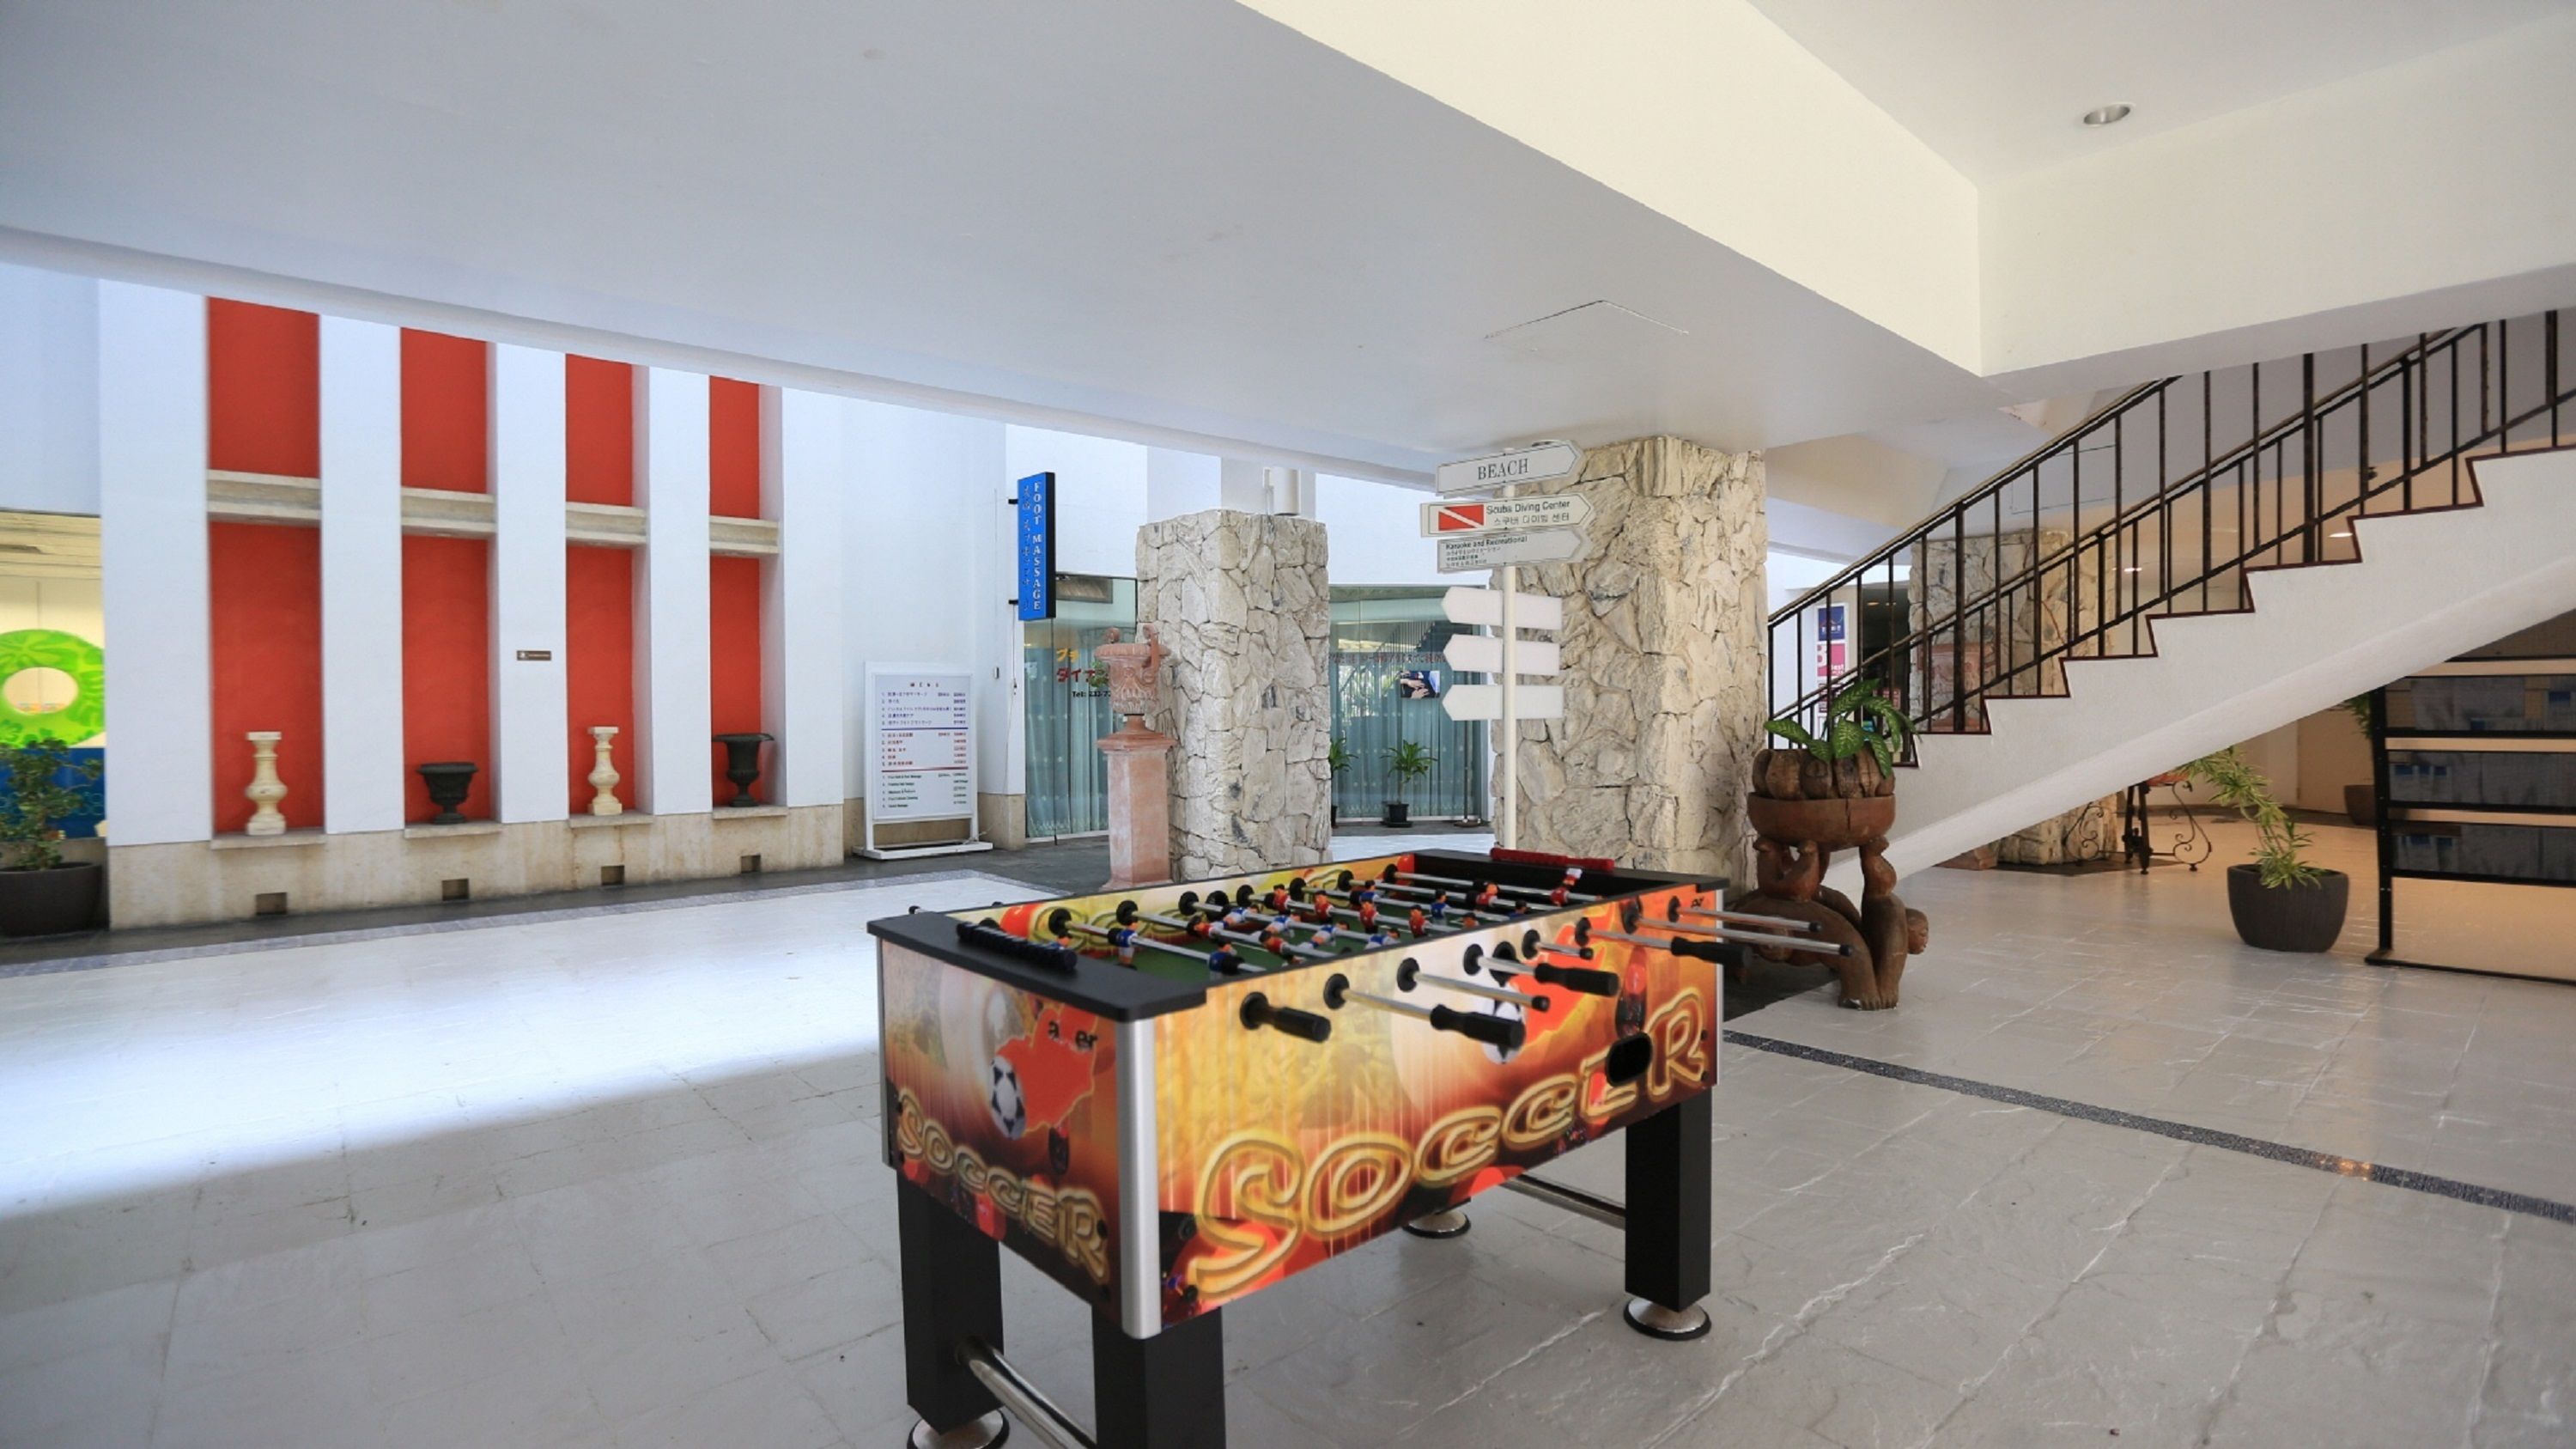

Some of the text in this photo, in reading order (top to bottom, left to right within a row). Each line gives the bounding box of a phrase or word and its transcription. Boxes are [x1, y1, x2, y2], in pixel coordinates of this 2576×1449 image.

[1478, 458, 1528, 480] BEACH
[1515, 502, 1540, 513] Diving
[1542, 501, 1570, 510] Center
[1032, 481, 1042, 610] FOOT MASSAGE
[899, 1087, 1110, 1284] SOCCER
